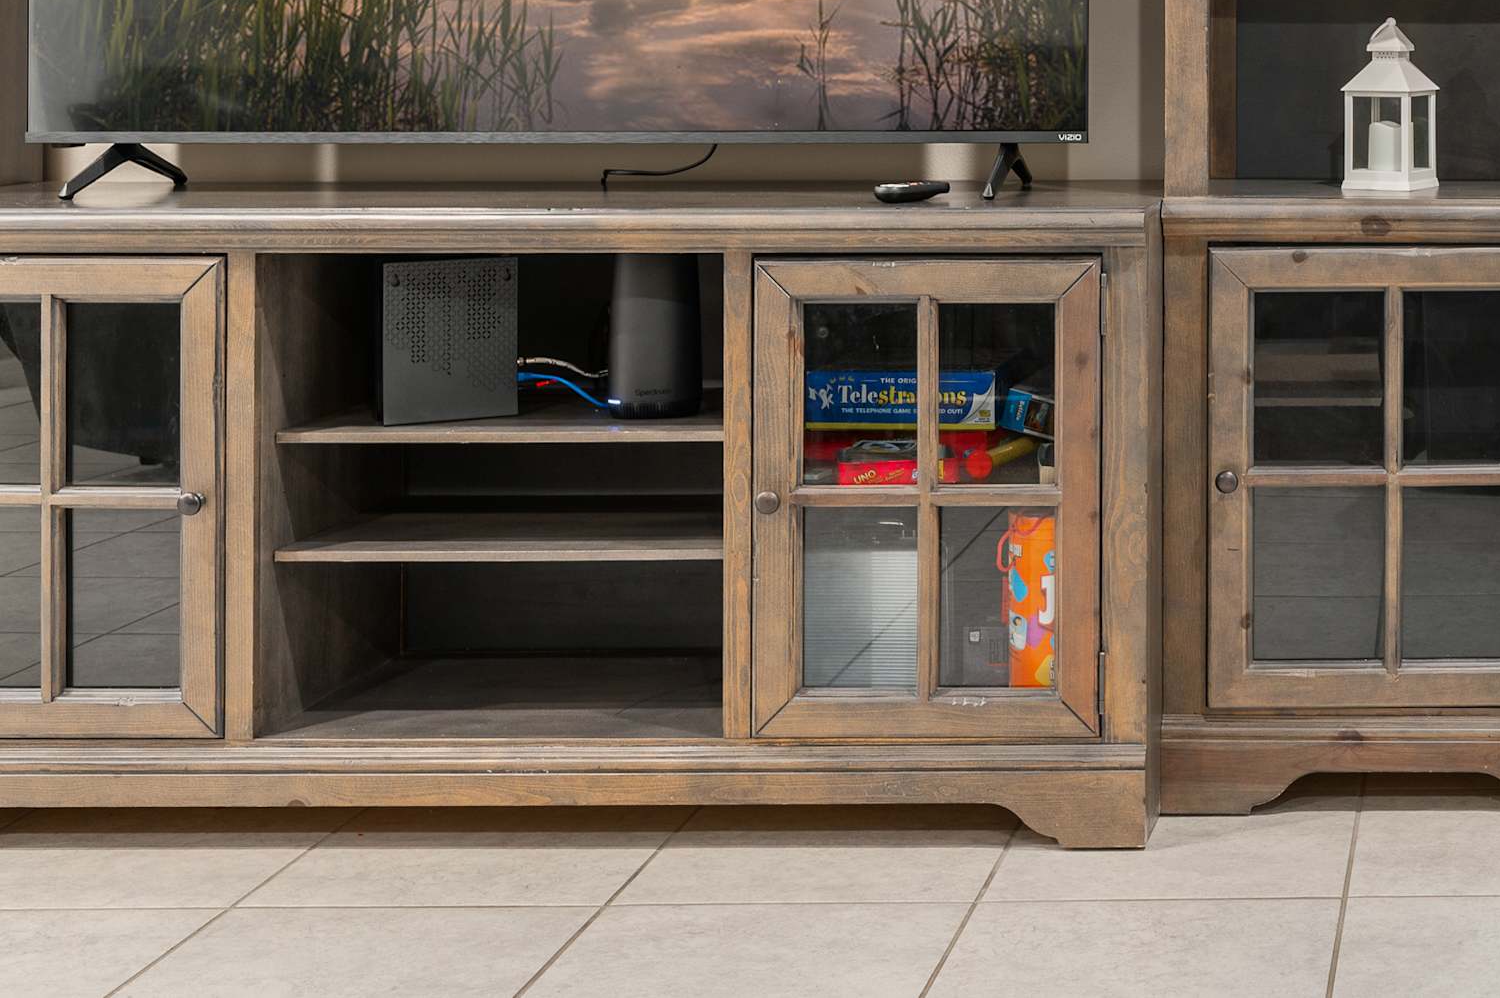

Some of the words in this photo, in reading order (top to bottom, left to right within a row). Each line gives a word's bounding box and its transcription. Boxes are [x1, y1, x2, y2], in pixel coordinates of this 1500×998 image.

[1058, 133, 1082, 141] VIZIO
[838, 384, 967, 407] Telestrans
[853, 469, 876, 484] UNO
